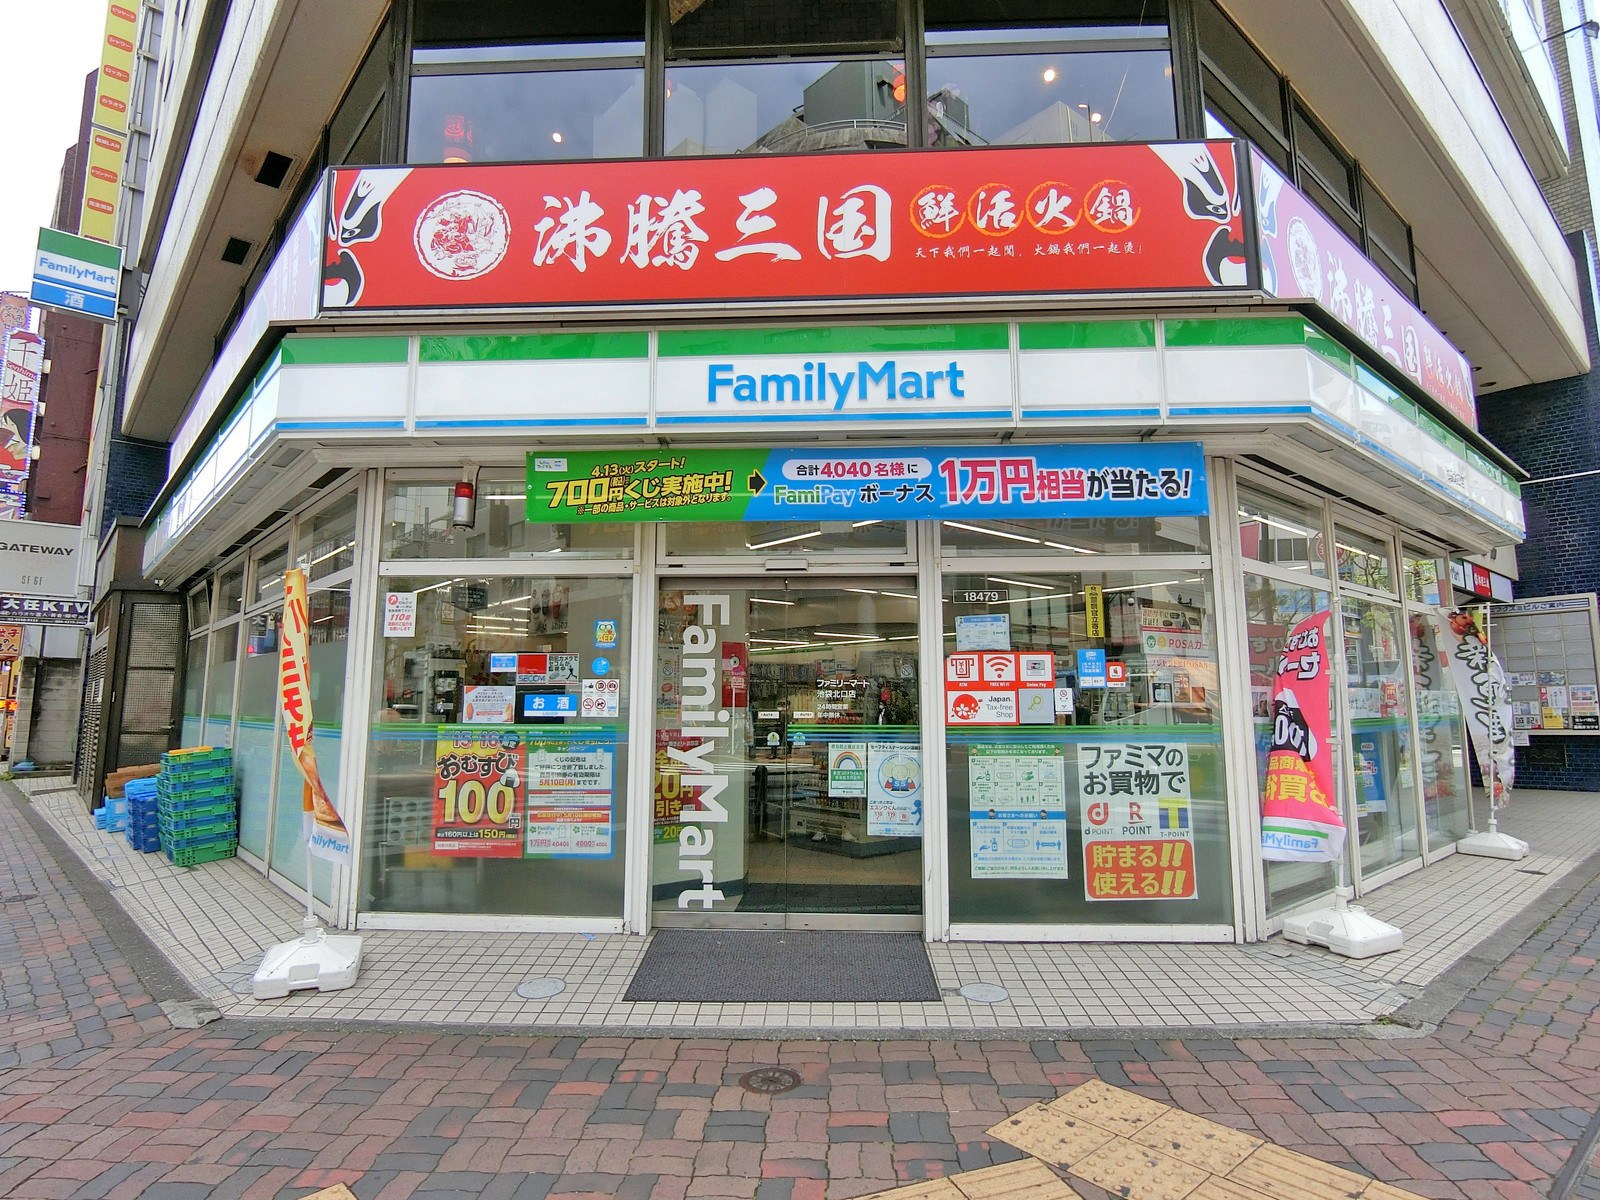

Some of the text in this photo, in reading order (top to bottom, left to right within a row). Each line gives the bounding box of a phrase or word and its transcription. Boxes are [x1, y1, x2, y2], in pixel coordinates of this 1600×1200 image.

[109, 37, 132, 51] シャワー
[105, 67, 128, 80] ロッカー
[101, 98, 125, 111] カラオケ
[916, 186, 1134, 232] 鮮活火鍋
[39, 256, 116, 287] FamilyMart
[64, 291, 85, 309] 酒
[708, 360, 964, 411] FamilyMart
[591, 456, 686, 478] 4.13(火)スタート!
[939, 457, 1192, 505] 1万円相当が当たる!
[774, 483, 934, 508] FamiPay ボーナス
[963, 591, 999, 602] 18479
[597, 634, 615, 642] AED
[518, 674, 546, 683] SECOM
[816, 679, 870, 688] ファミリーマート
[816, 690, 856, 698] 池袋北口店
[996, 711, 1014, 719] Shop
[667, 594, 731, 909] FamilyMart
[1080, 743, 1184, 770] ファミマの
[437, 750, 520, 780] おむすび
[1083, 769, 1187, 797] お買物で
[438, 779, 516, 824] 100
[656, 800, 683, 817] 引き
[508, 816, 521, 829] 円
[1122, 826, 1153, 836] POINT
[1091, 828, 1115, 836] POINT
[1092, 842, 1187, 869] 貯まる!!
[1092, 870, 1188, 896] 使える!!
